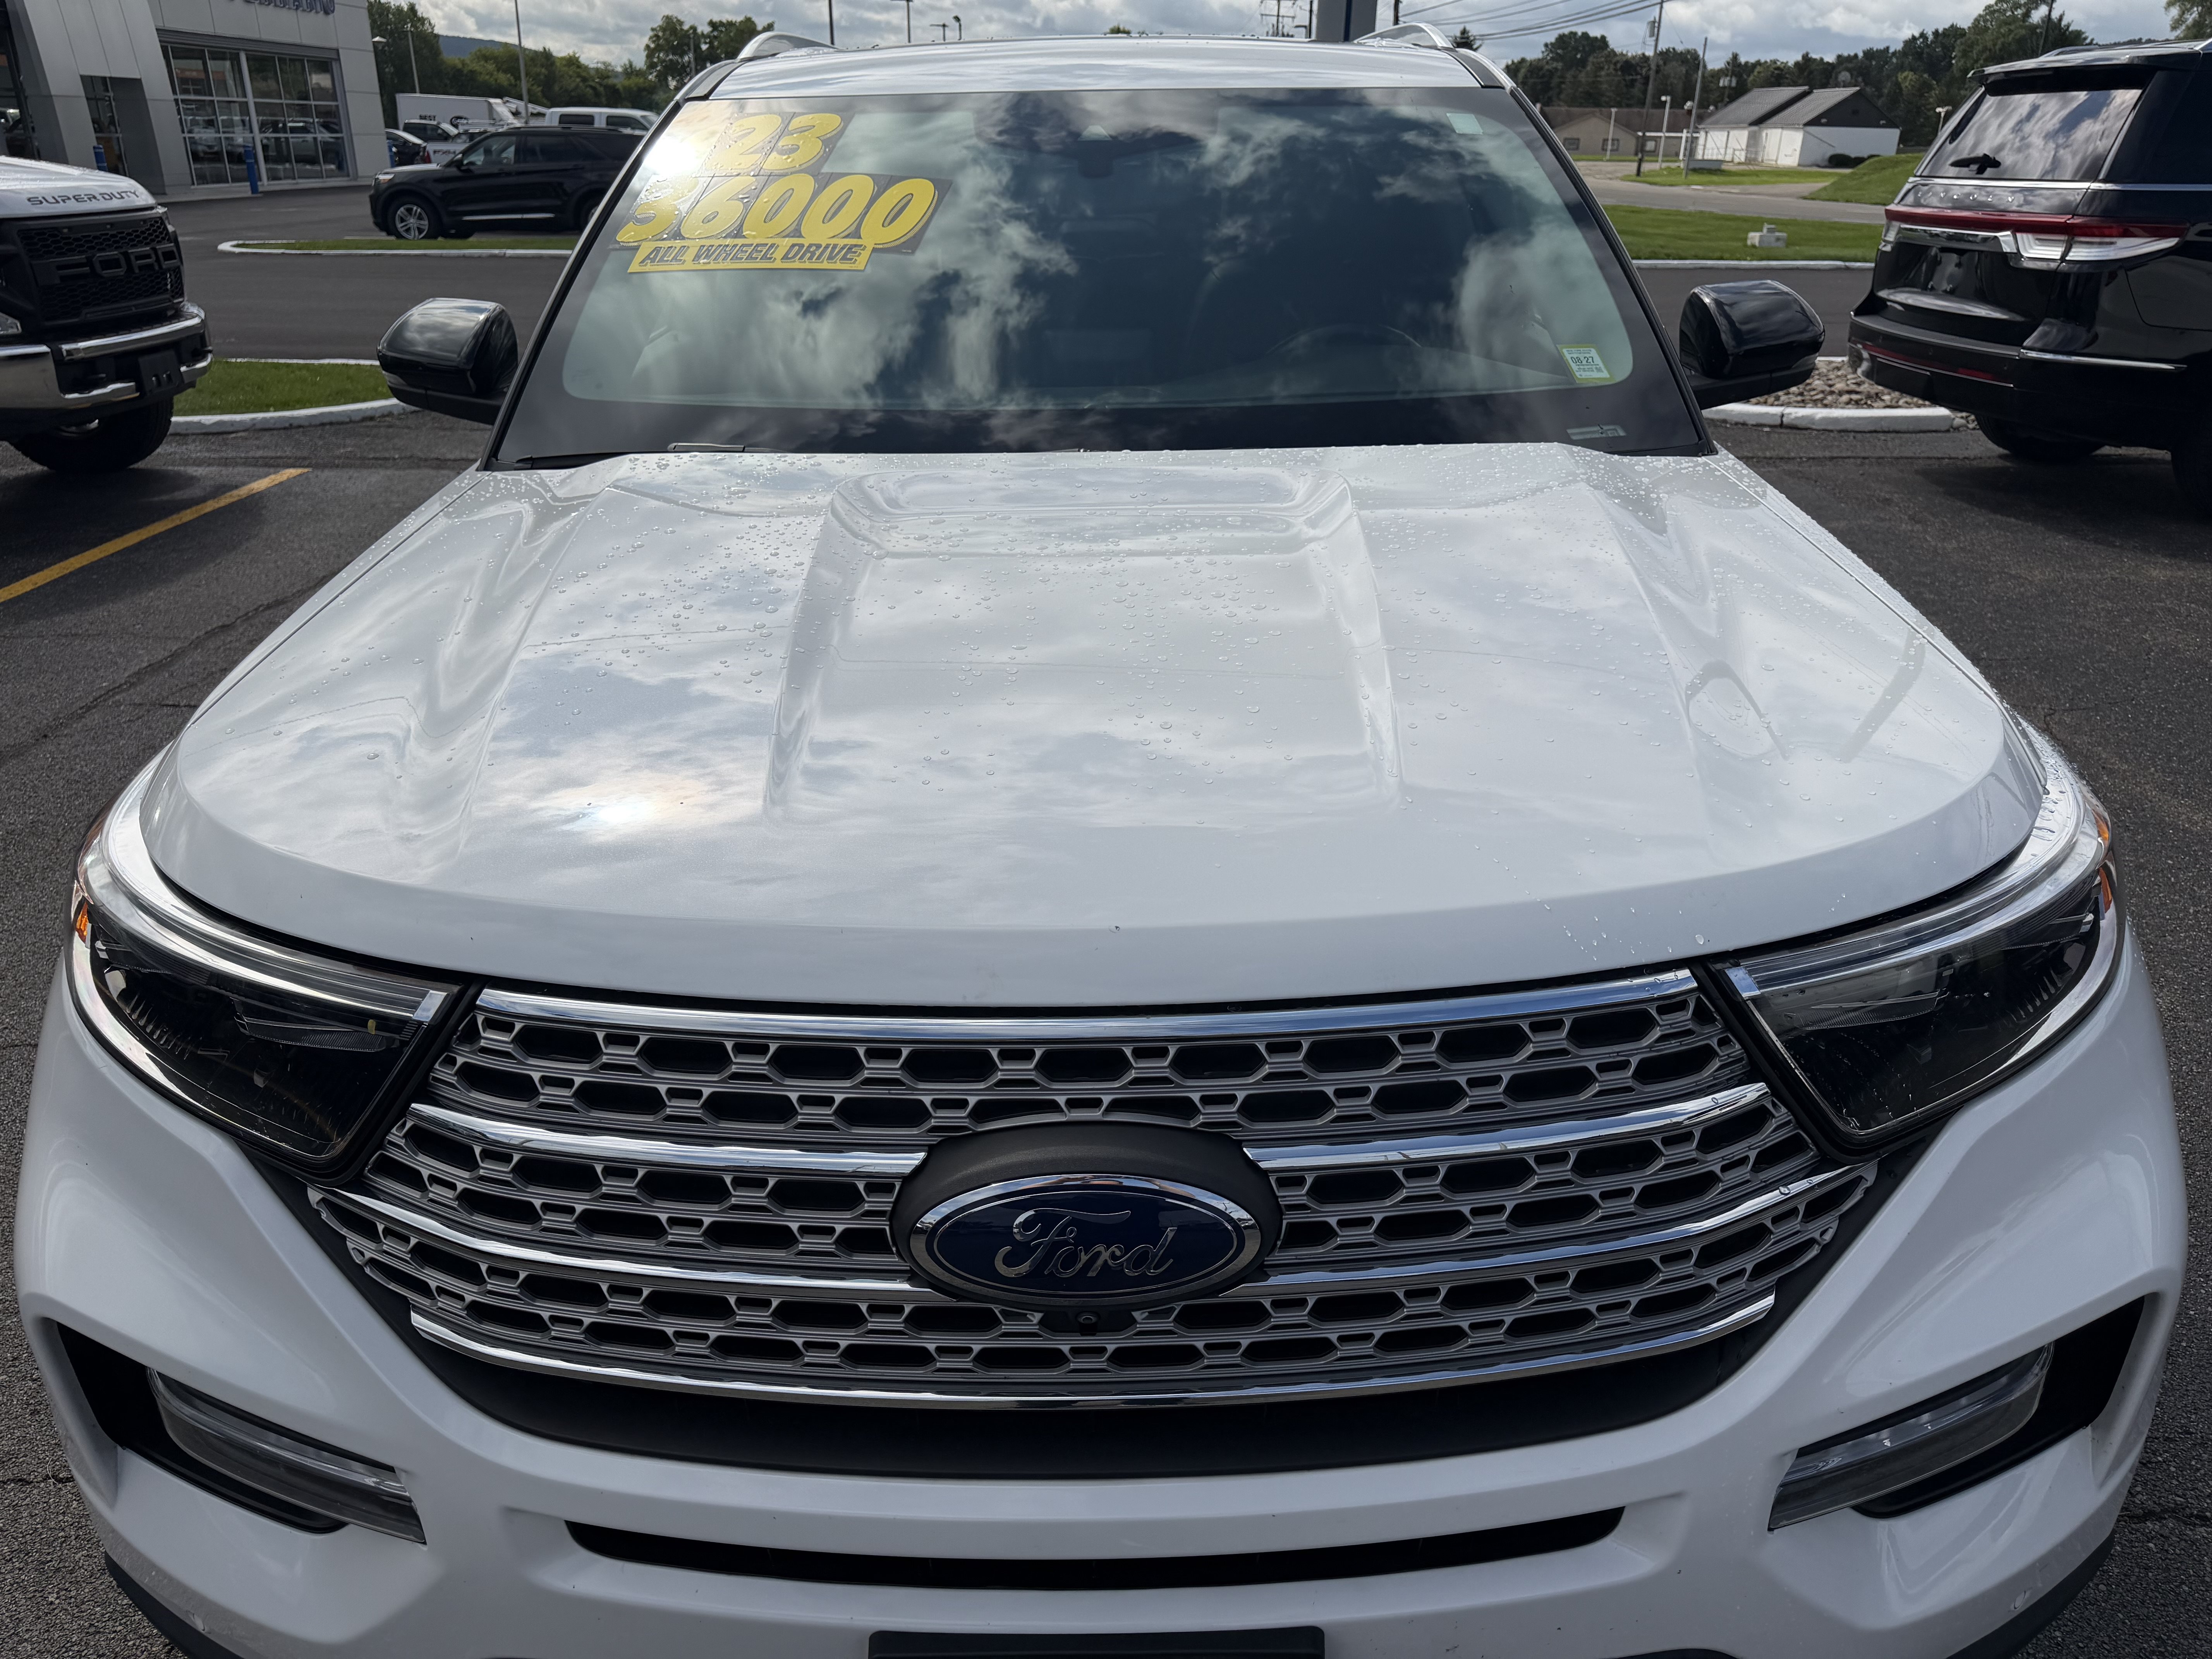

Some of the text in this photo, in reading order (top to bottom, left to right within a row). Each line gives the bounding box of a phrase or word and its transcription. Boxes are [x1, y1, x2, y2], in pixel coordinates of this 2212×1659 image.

[704, 113, 843, 172] 23
[27, 190, 139, 205] SUPER DUTY
[616, 173, 938, 248] 36000
[30, 243, 181, 286] FORD
[639, 242, 867, 266] ALL WHEEL DRIVE
[994, 1207, 1177, 1278] Ford
